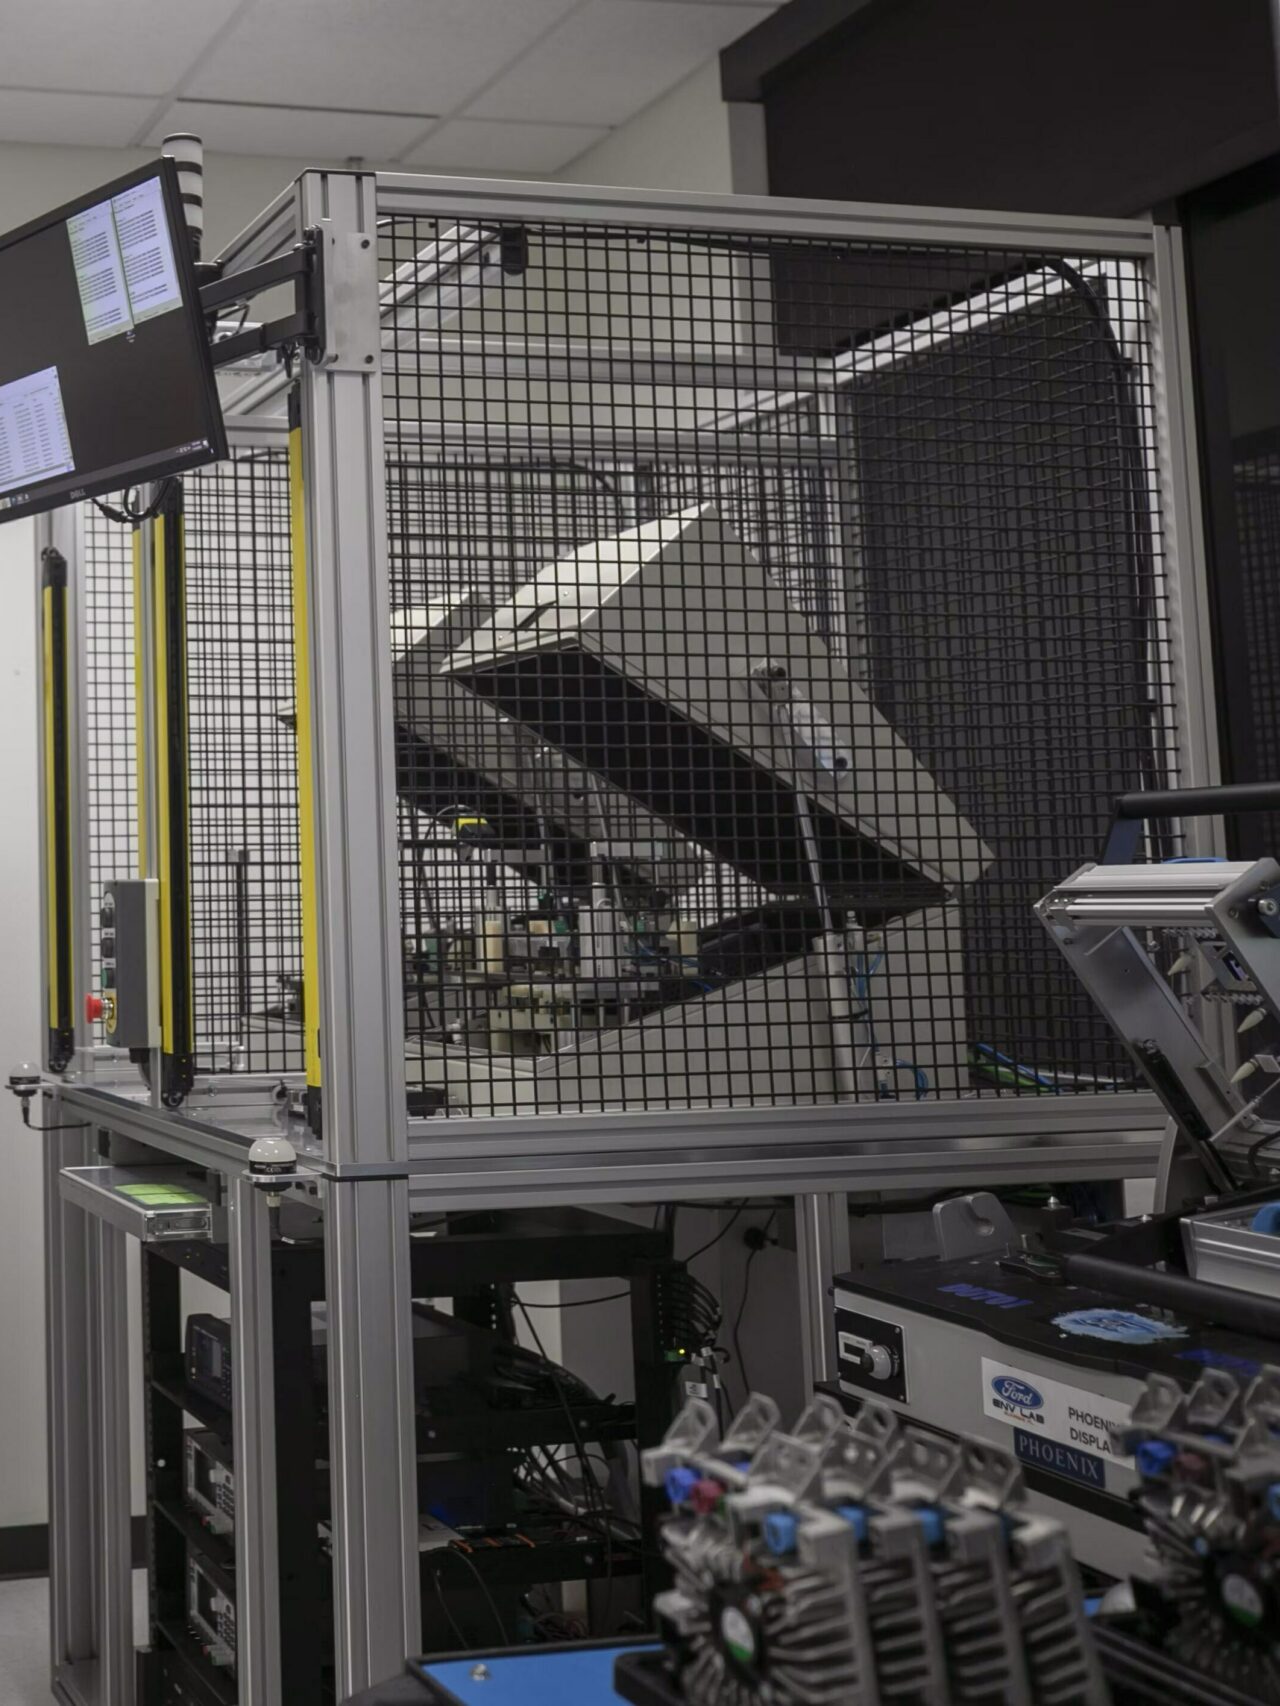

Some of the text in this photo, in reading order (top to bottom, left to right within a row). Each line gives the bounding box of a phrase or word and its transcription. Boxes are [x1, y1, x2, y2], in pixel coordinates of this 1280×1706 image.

[1001, 1380, 1034, 1406] Ford
[992, 1398, 1016, 1413] ENV
[1019, 1408, 1045, 1425] LAB
[1068, 1406, 1120, 1433] PHOENI
[1069, 1426, 1112, 1454] DISPLA
[1020, 1434, 1099, 1480] PHOENIX
